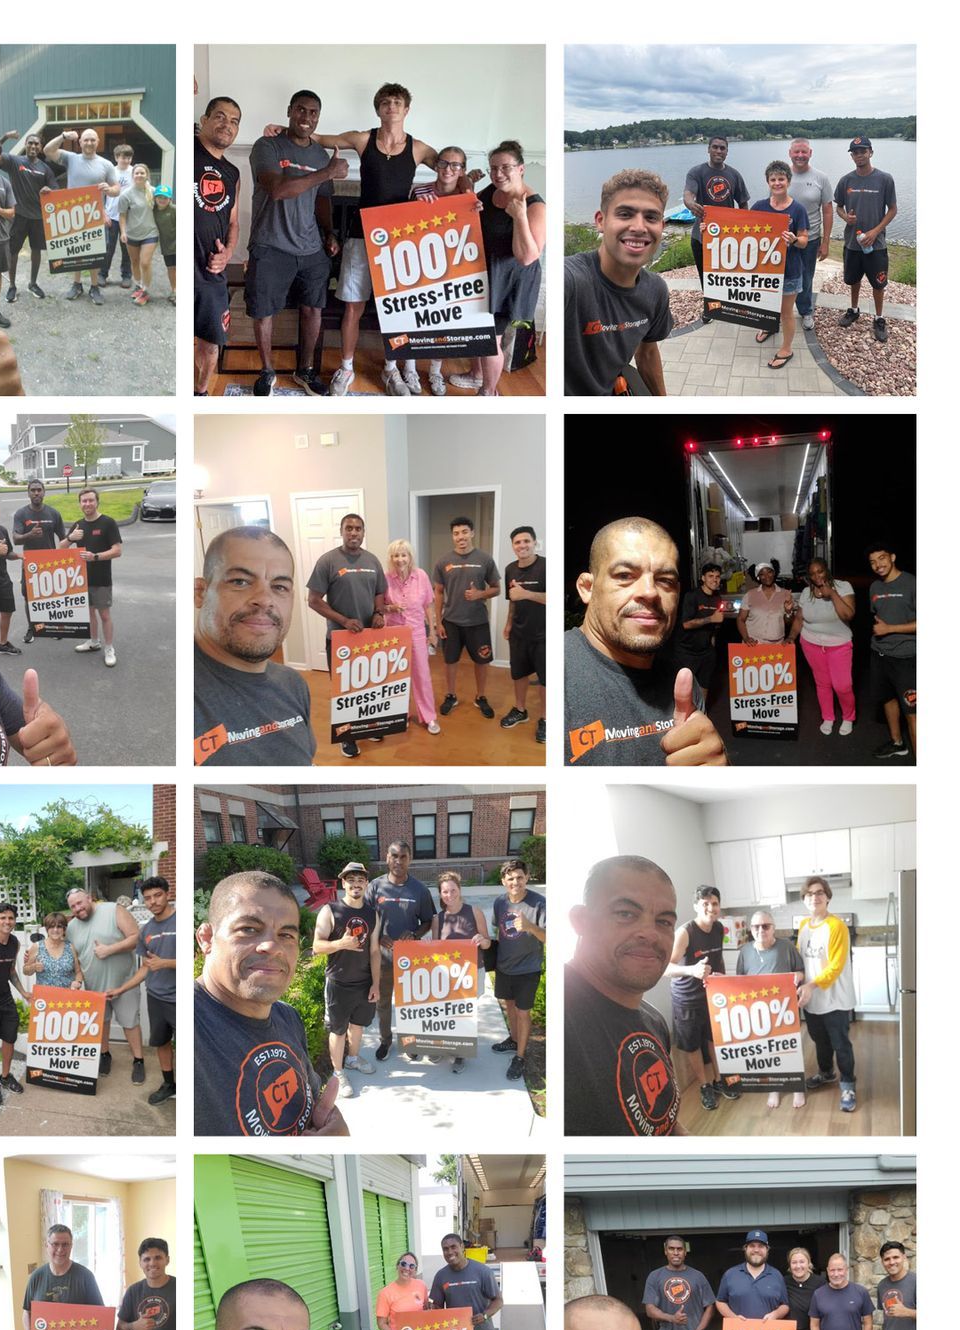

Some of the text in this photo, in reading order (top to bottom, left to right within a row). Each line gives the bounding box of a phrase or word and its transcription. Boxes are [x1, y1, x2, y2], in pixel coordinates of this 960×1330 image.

[374, 224, 478, 290] 100%
[707, 237, 781, 270] 100%
[708, 273, 780, 288] Stress-Free
[382, 279, 484, 314] Stress-Free
[728, 289, 761, 302] Move
[414, 306, 462, 328] Move
[336, 648, 407, 692] 100%
[336, 682, 406, 710] Stress-Free
[358, 701, 391, 718] Move
[200, 734, 218, 752] CT
[579, 730, 597, 746] CT
[254, 1051, 272, 1067] EST.
[271, 1081, 291, 1104] CT
[646, 1072, 661, 1092] CT
